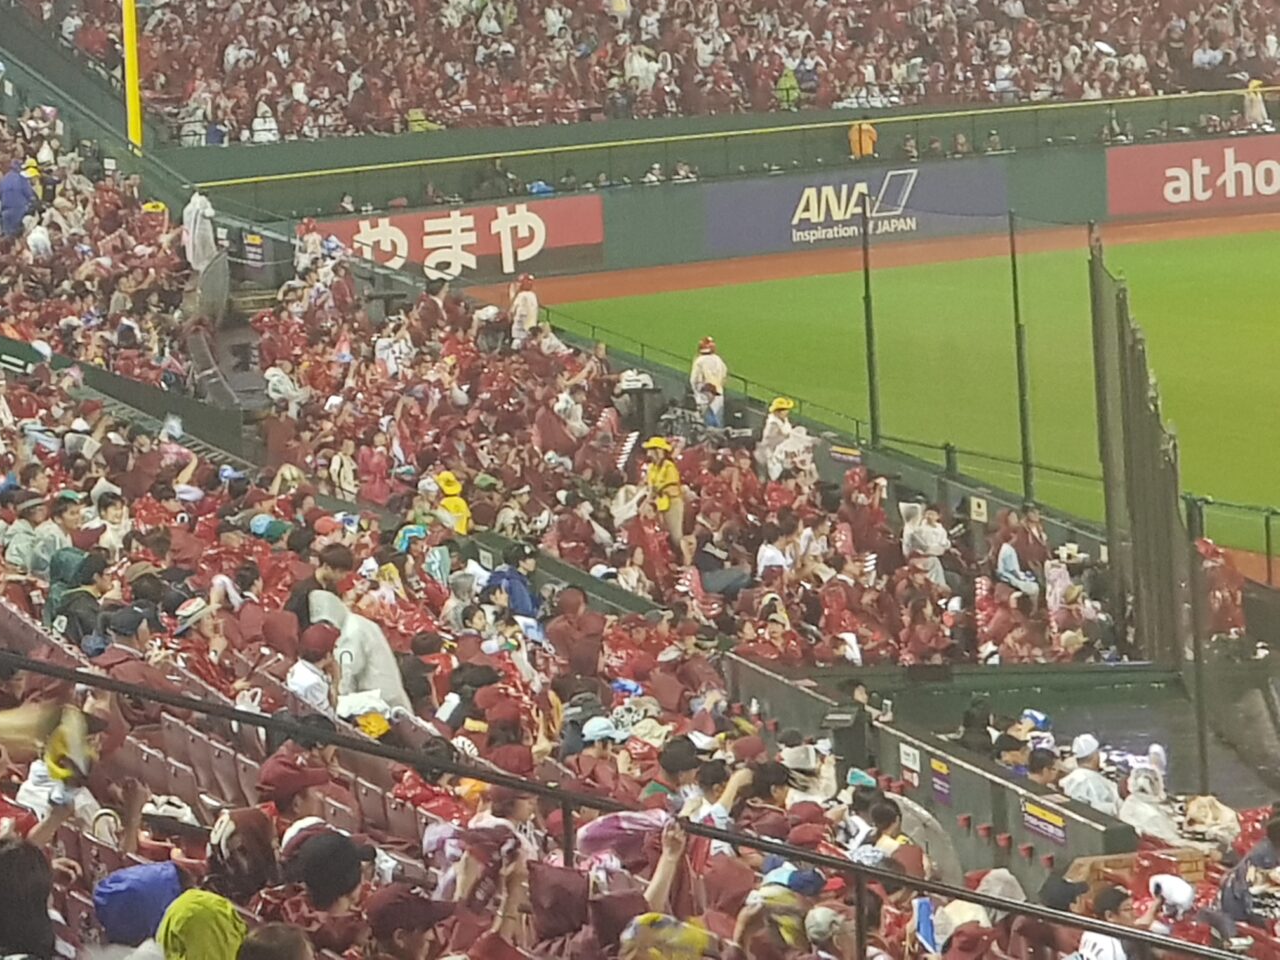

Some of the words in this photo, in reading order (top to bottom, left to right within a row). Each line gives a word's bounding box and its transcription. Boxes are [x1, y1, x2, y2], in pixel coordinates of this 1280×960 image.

[1163, 158, 1213, 203] at
[791, 182, 871, 225] ANA
[353, 203, 546, 280] やまや
[792, 223, 858, 243] Inspiration
[875, 216, 917, 234] JAPAN
